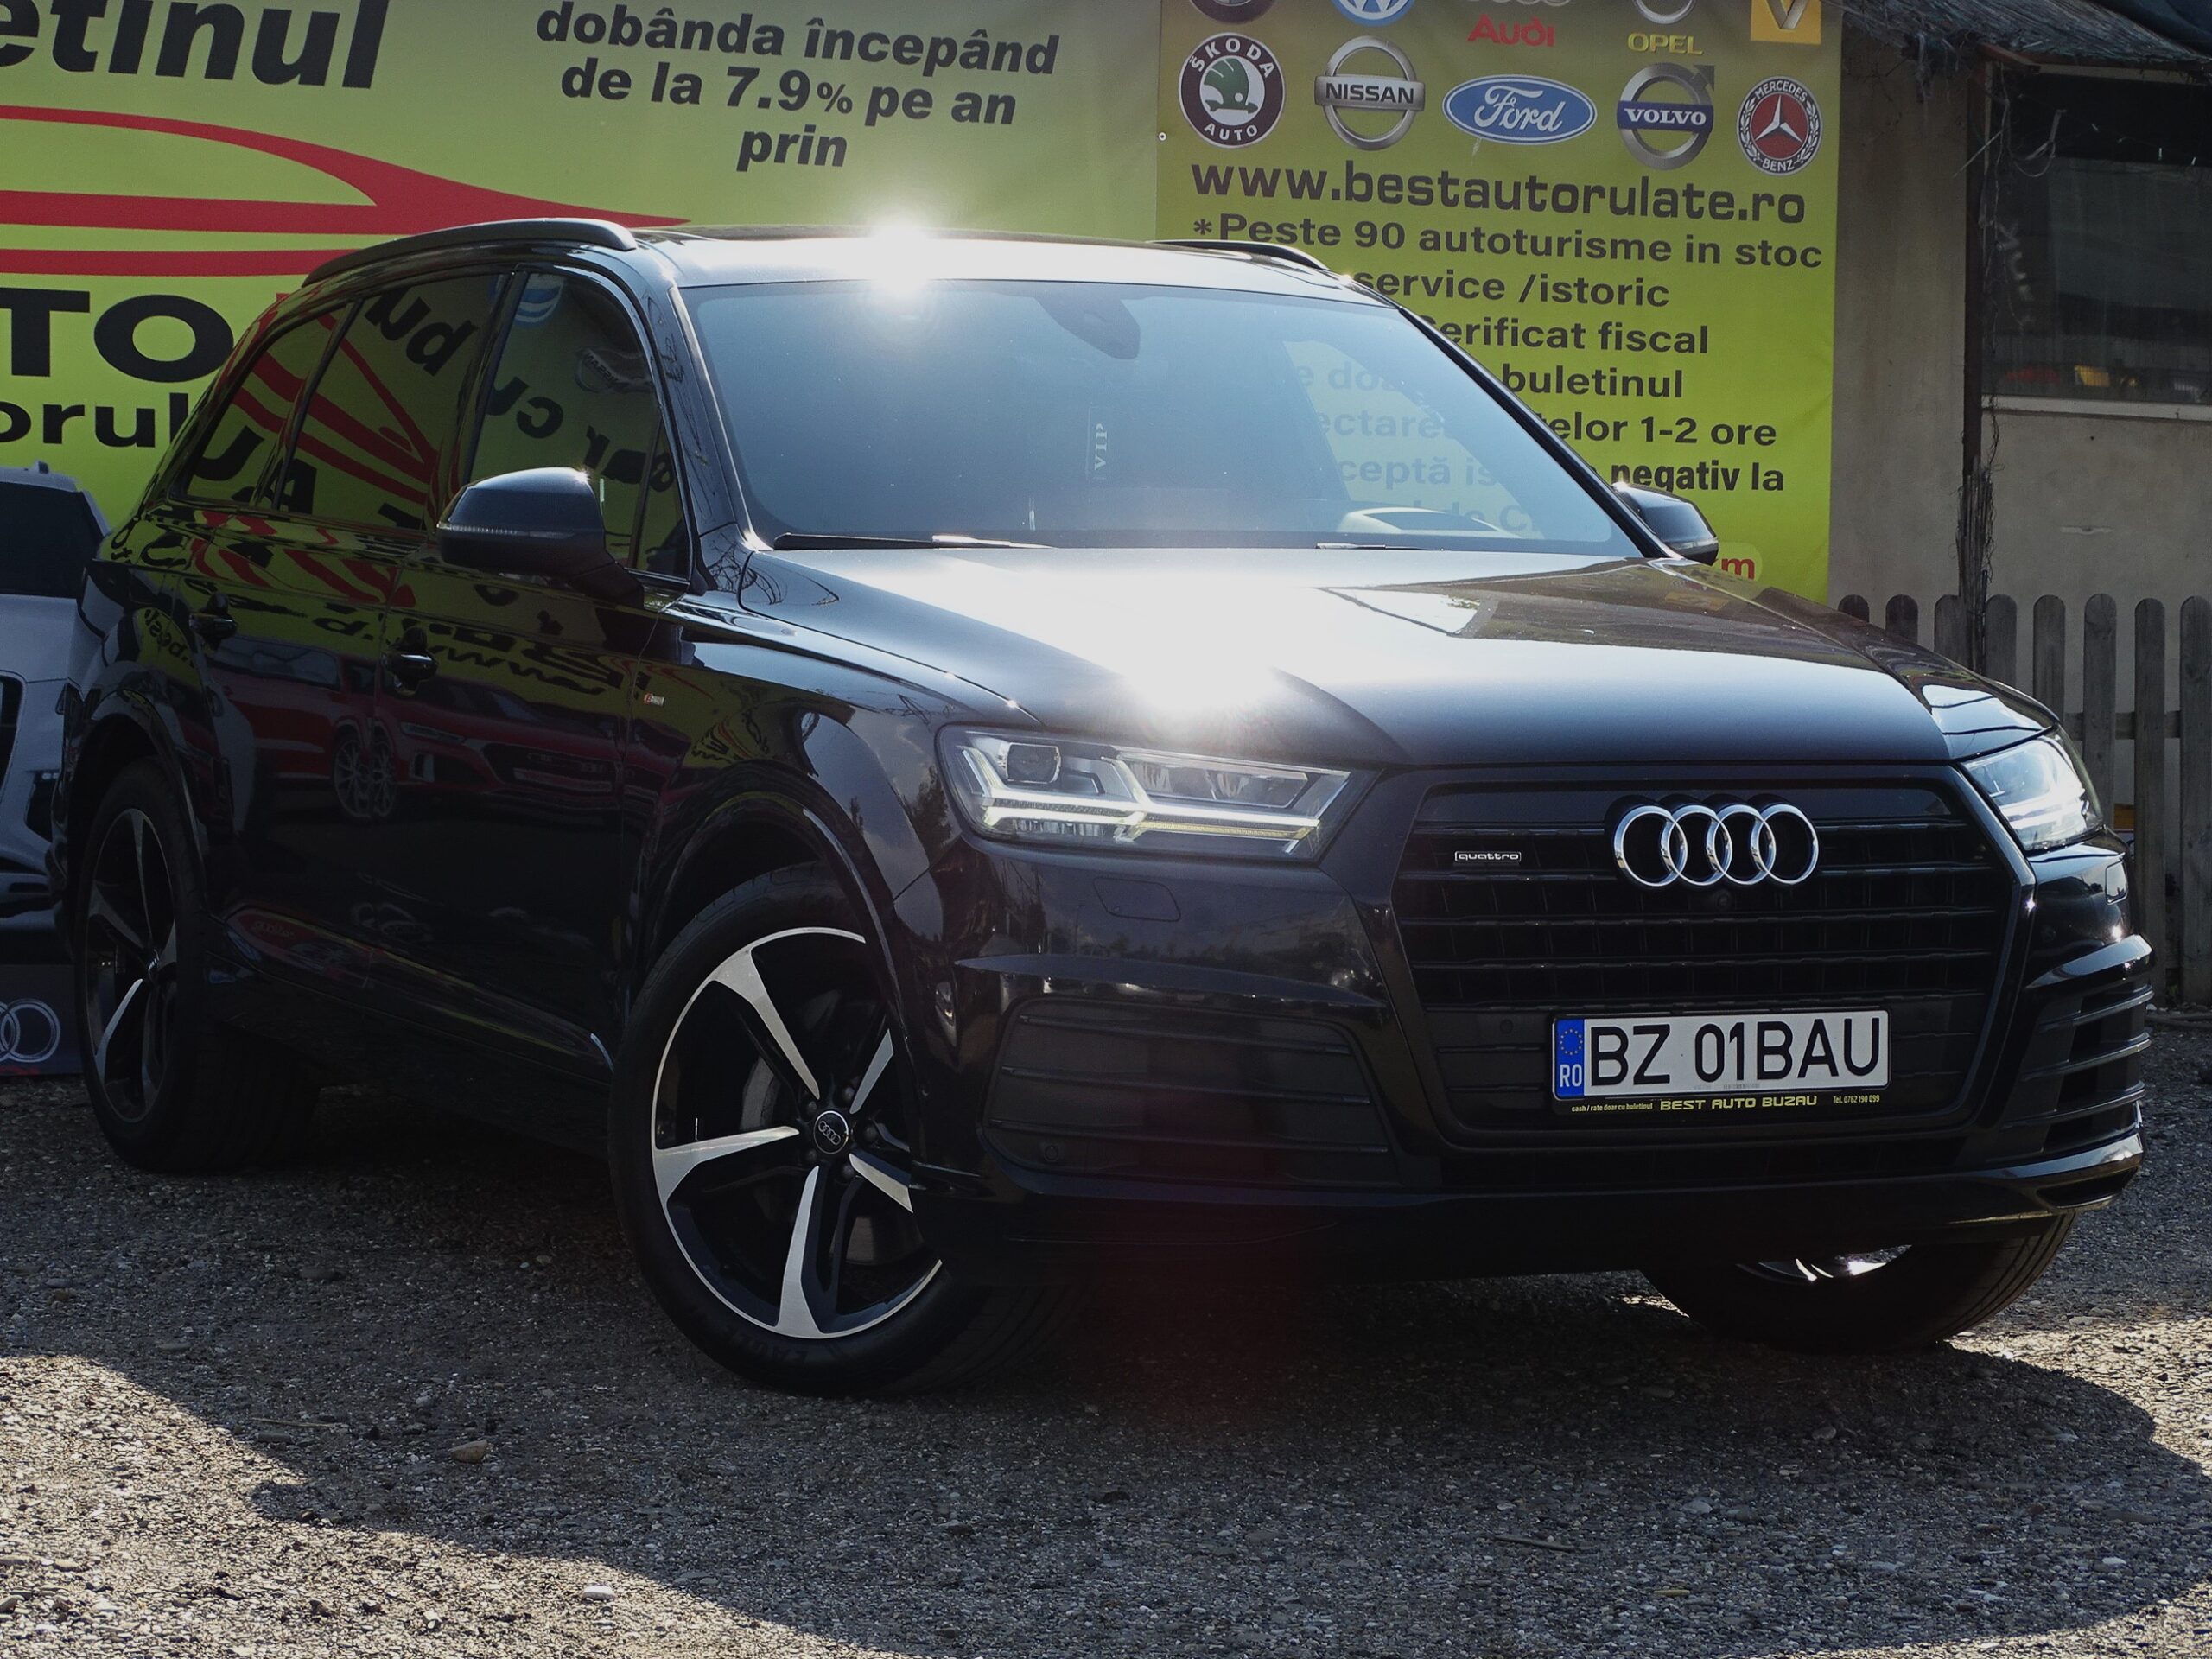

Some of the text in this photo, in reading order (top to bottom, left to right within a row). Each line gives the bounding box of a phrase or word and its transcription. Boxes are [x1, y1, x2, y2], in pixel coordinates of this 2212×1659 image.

[537, 2, 1059, 77] dobânda începând
[1628, 33, 1703, 55] OPEL
[562, 57, 632, 99] de
[651, 61, 702, 105] la
[865, 86, 933, 127] pe
[950, 92, 1016, 124] an
[1325, 82, 1414, 104] NISSAN
[1755, 80, 1807, 102] MERCEDES
[1474, 86, 1566, 132] Ford
[1624, 108, 1707, 125] VOLVO
[736, 124, 847, 172] prin
[1205, 124, 1257, 141] AUTO
[1762, 159, 1795, 172] BENZ
[1192, 160, 1805, 224] www.bestautorulate.ro
[1354, 221, 1405, 250] 90
[1419, 226, 1672, 262] autoturisme
[1685, 234, 1720, 264] in
[1735, 240, 1822, 268] stoc
[1353, 269, 1505, 301] service
[1599, 321, 1708, 353] fiscal
[1503, 363, 1682, 397] buletinul
[1641, 416, 1697, 443] 1-2
[1711, 423, 1777, 446] ore
[1611, 460, 1741, 493] negativ
[1751, 462, 1783, 491] la
[1591, 1024, 1671, 1086] BZ
[1560, 1064, 1582, 1087] RO
[1660, 1096, 1817, 1110] BEST AUTO BUZAU
